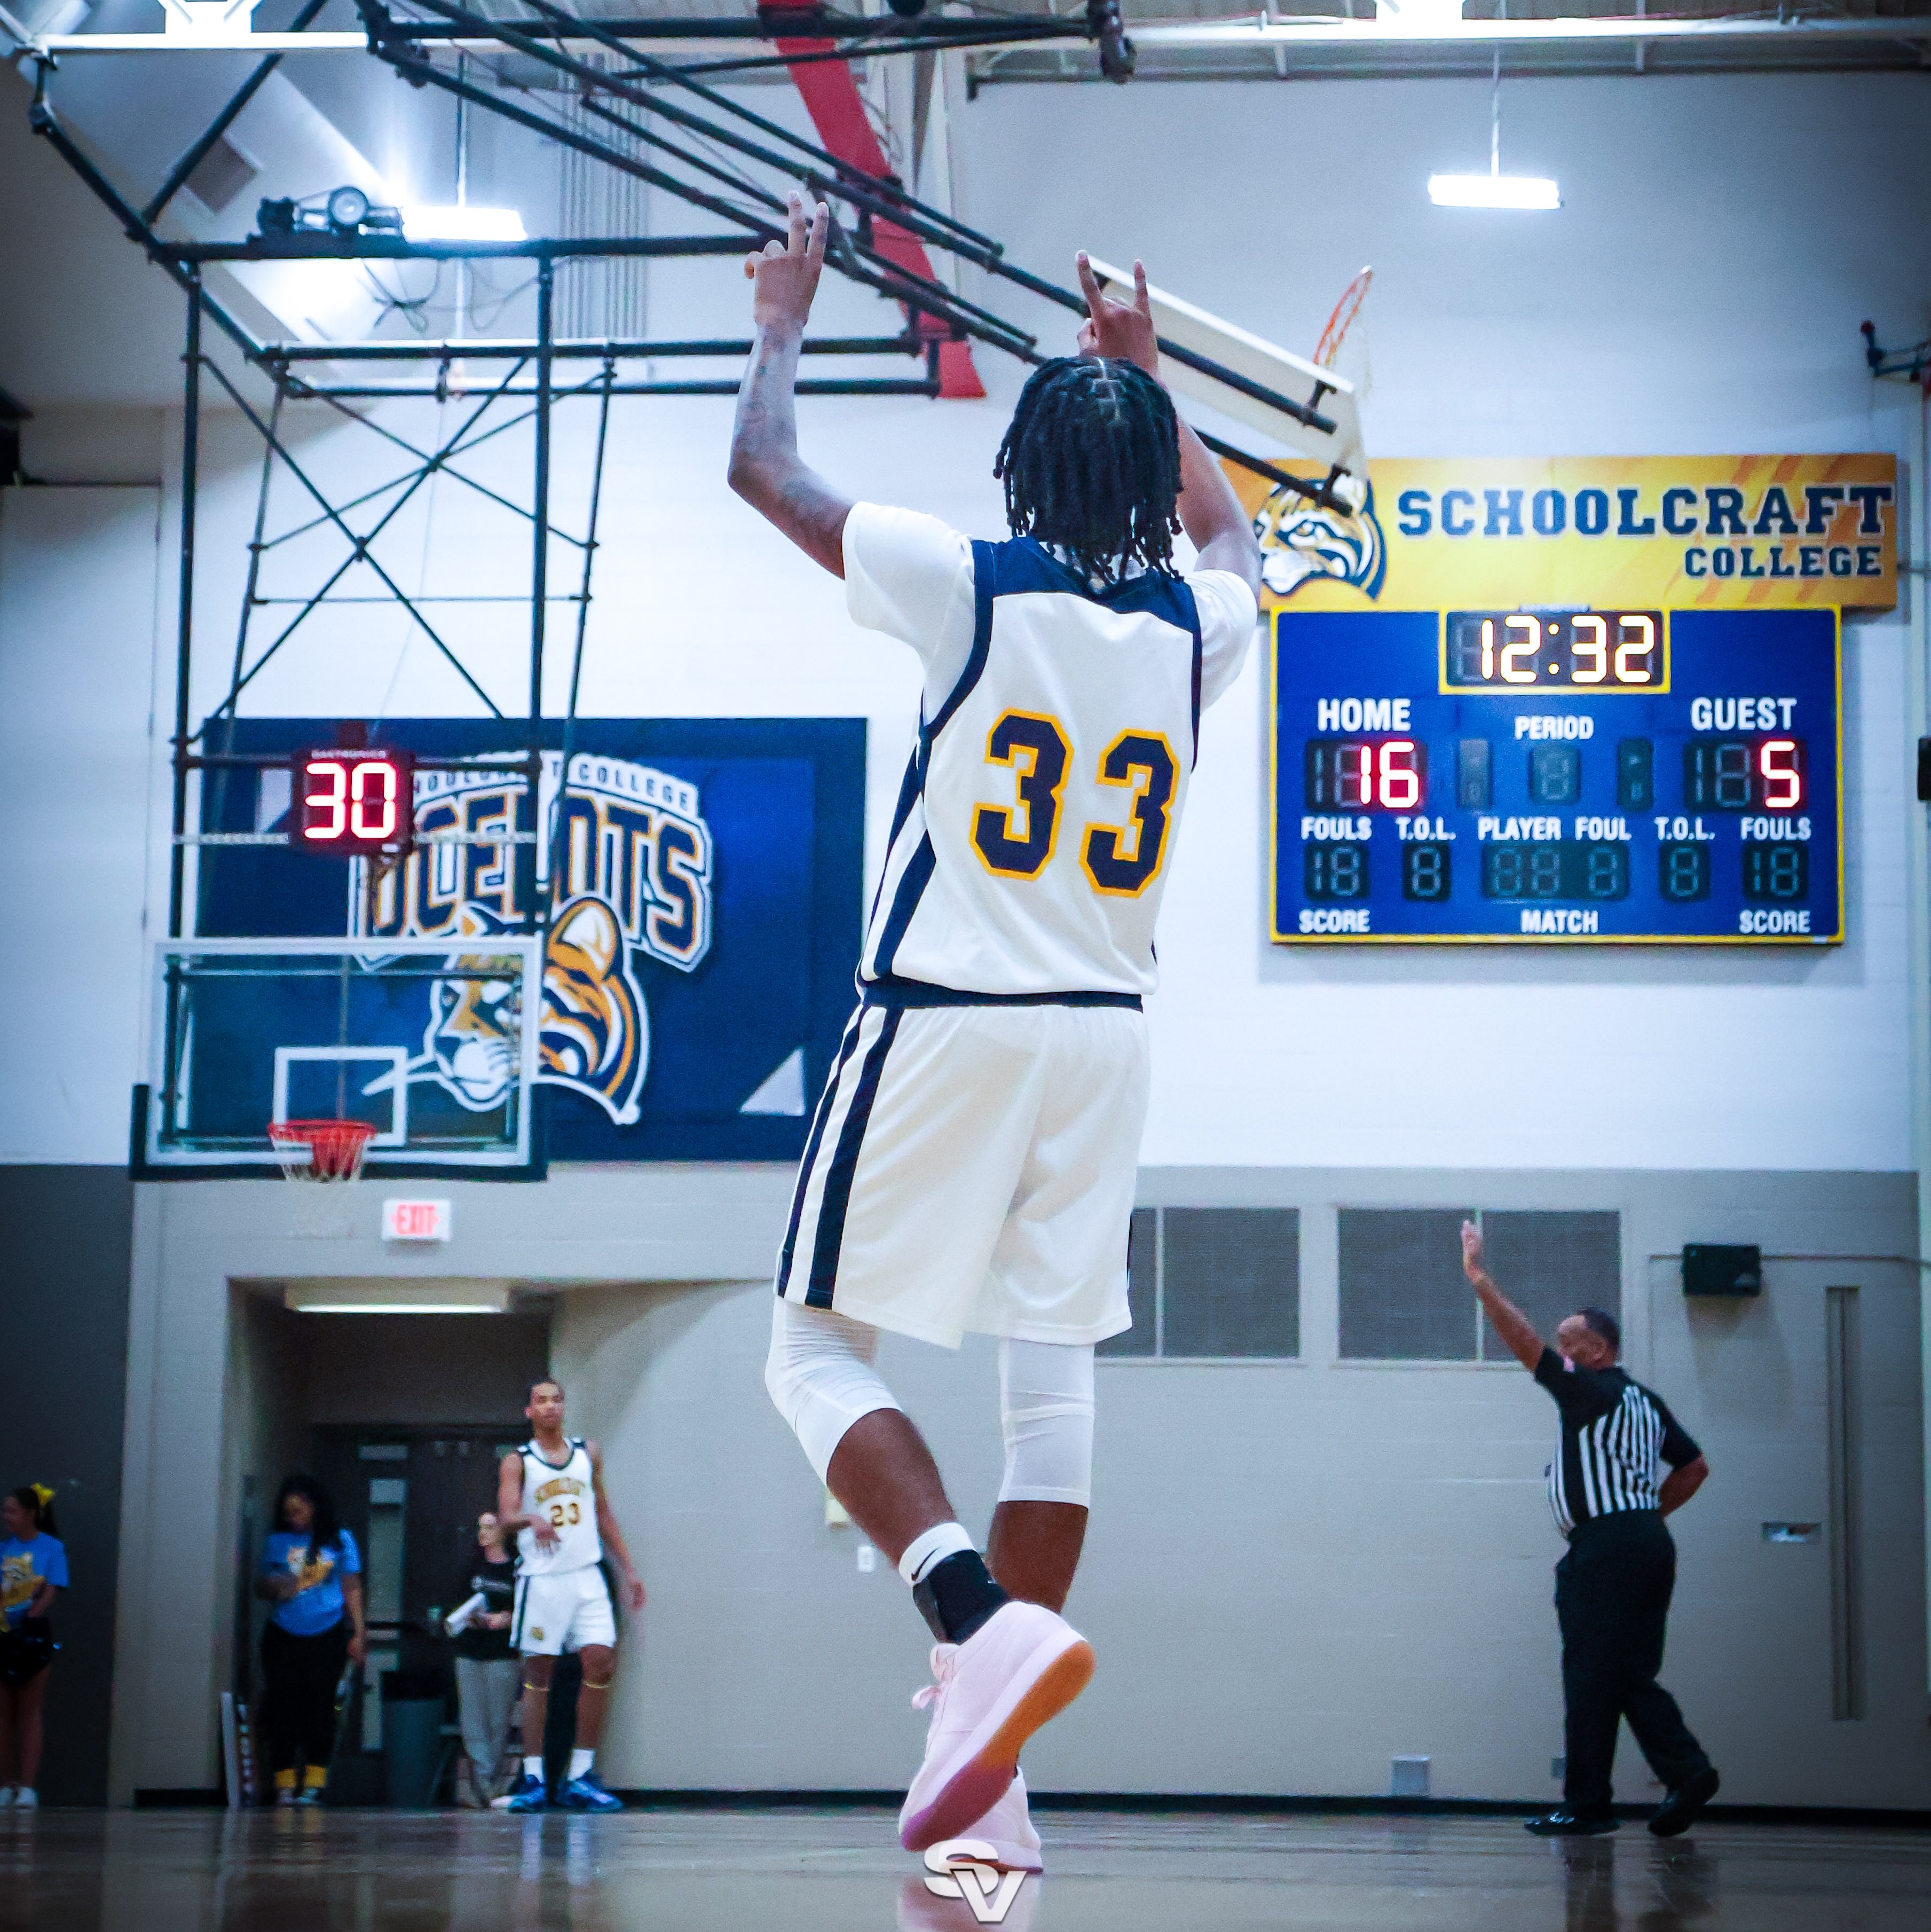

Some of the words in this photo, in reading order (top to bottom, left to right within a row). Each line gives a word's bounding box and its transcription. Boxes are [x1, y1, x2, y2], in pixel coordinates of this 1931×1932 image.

[1398, 486, 1893, 536] SCHOOLCRAFT
[1684, 546, 1882, 578] COLLEGE
[1481, 615, 1654, 684] 12:32
[1317, 698, 1411, 732] HOME
[1515, 716, 1594, 740] PERIOD
[1690, 697, 1797, 731] GUEST
[579, 763, 688, 812] COLLEGE
[1360, 741, 1419, 807] 16
[1761, 741, 1800, 807] 5
[305, 763, 396, 839] 30
[969, 707, 1180, 899] 33
[1301, 816, 1373, 841] FOULS
[1396, 816, 1456, 841] T.O.L.
[1478, 817, 1562, 841] PLAYER
[1575, 817, 1632, 841] FOUL
[1655, 817, 1715, 841] T.O.L.
[1740, 817, 1812, 841] FOULS
[1298, 909, 1371, 934] SCORE
[1520, 909, 1599, 934] MATCH
[1739, 910, 1811, 934] SCORE
[395, 1204, 436, 1236] EXIT
[550, 1502, 581, 1527] 23
